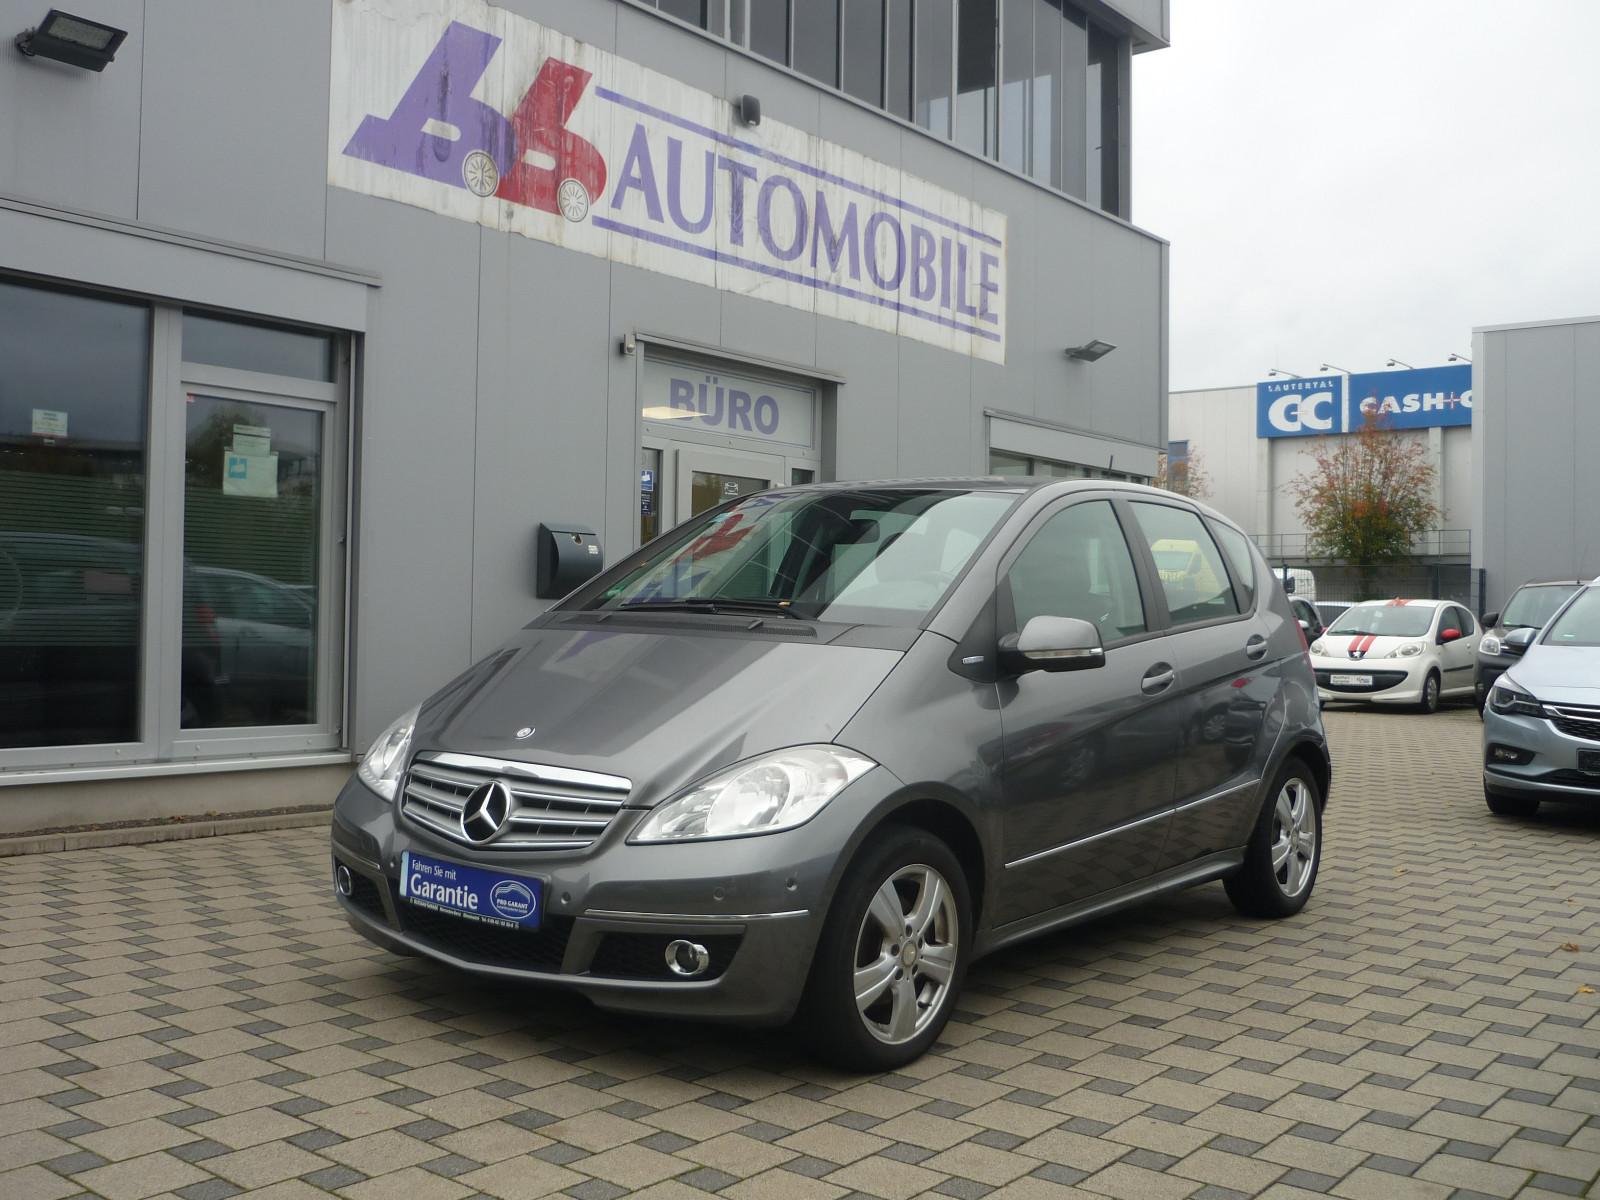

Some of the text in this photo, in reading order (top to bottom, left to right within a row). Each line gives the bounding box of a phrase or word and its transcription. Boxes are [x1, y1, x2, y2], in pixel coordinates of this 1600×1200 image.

[610, 122, 1000, 326] AUTOMOBILE
[1268, 380, 1334, 392] LAUTERTAL
[670, 375, 780, 436] BÜRO
[412, 859, 456, 880] Fahren Sie mit
[410, 873, 478, 910] Garantie
[507, 900, 528, 909] GARANT
